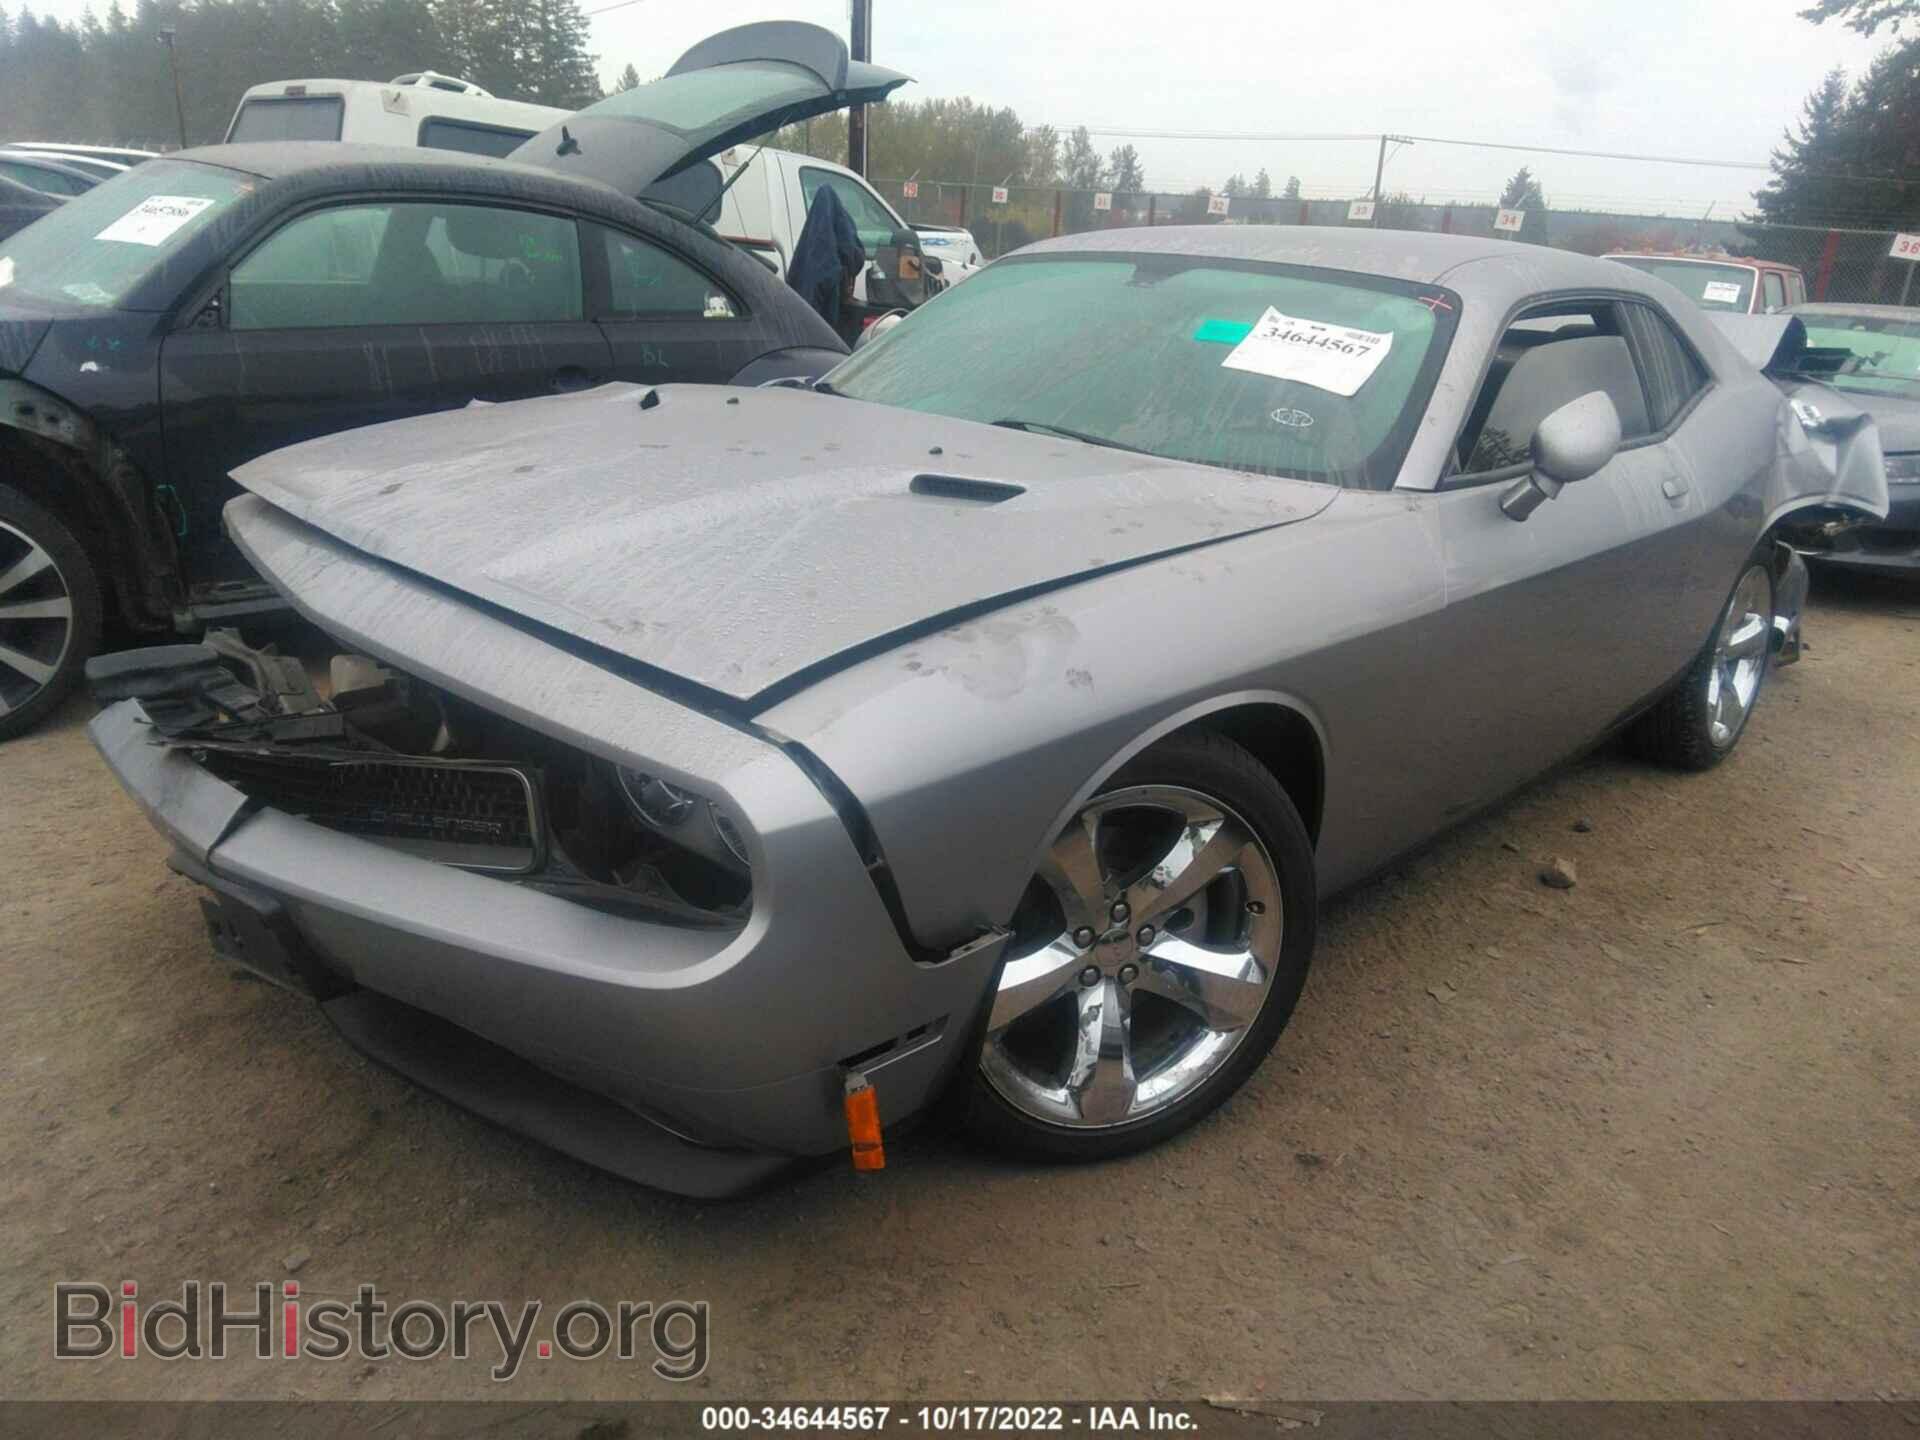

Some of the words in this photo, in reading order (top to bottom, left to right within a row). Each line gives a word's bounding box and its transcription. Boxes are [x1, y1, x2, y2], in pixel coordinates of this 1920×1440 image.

[1502, 214, 1517, 226] 34
[1899, 240, 1920, 254] 36
[1263, 327, 1371, 357] 34644567
